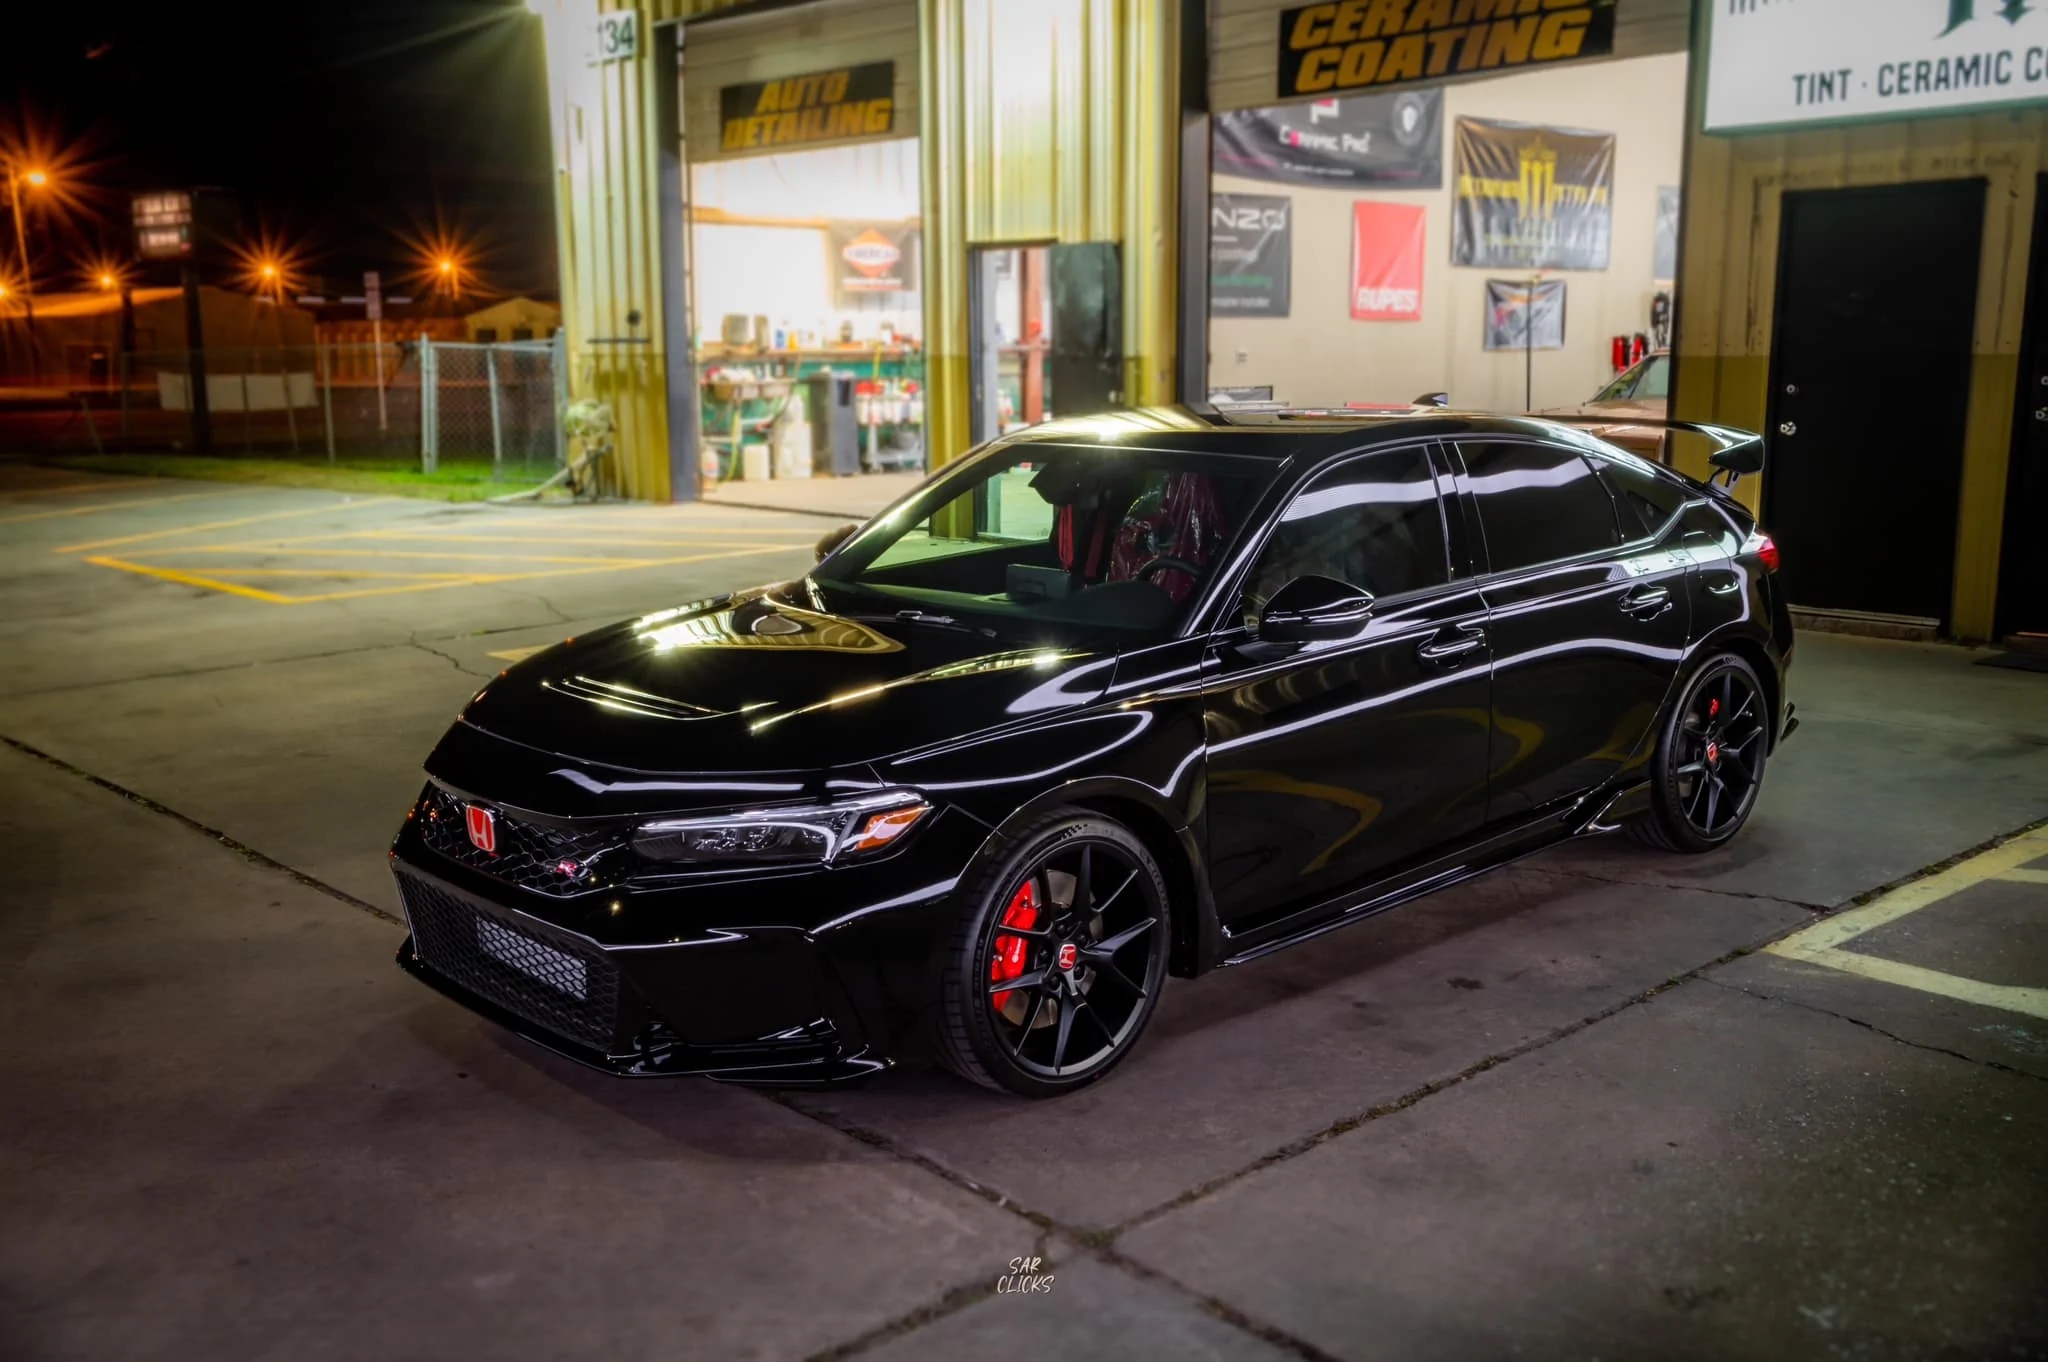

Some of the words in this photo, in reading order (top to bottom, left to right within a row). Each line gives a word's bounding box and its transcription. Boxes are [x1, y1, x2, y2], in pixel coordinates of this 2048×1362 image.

[1289, 0, 1590, 50] CERAM
[1295, 7, 1593, 93] COATING
[756, 71, 850, 115] AUTO
[1793, 69, 1852, 105] TINT
[1878, 50, 2013, 97] CERAMIC
[2024, 46, 2048, 82] C
[722, 98, 893, 149] DETAILING
[1358, 287, 1418, 313] RUPES
